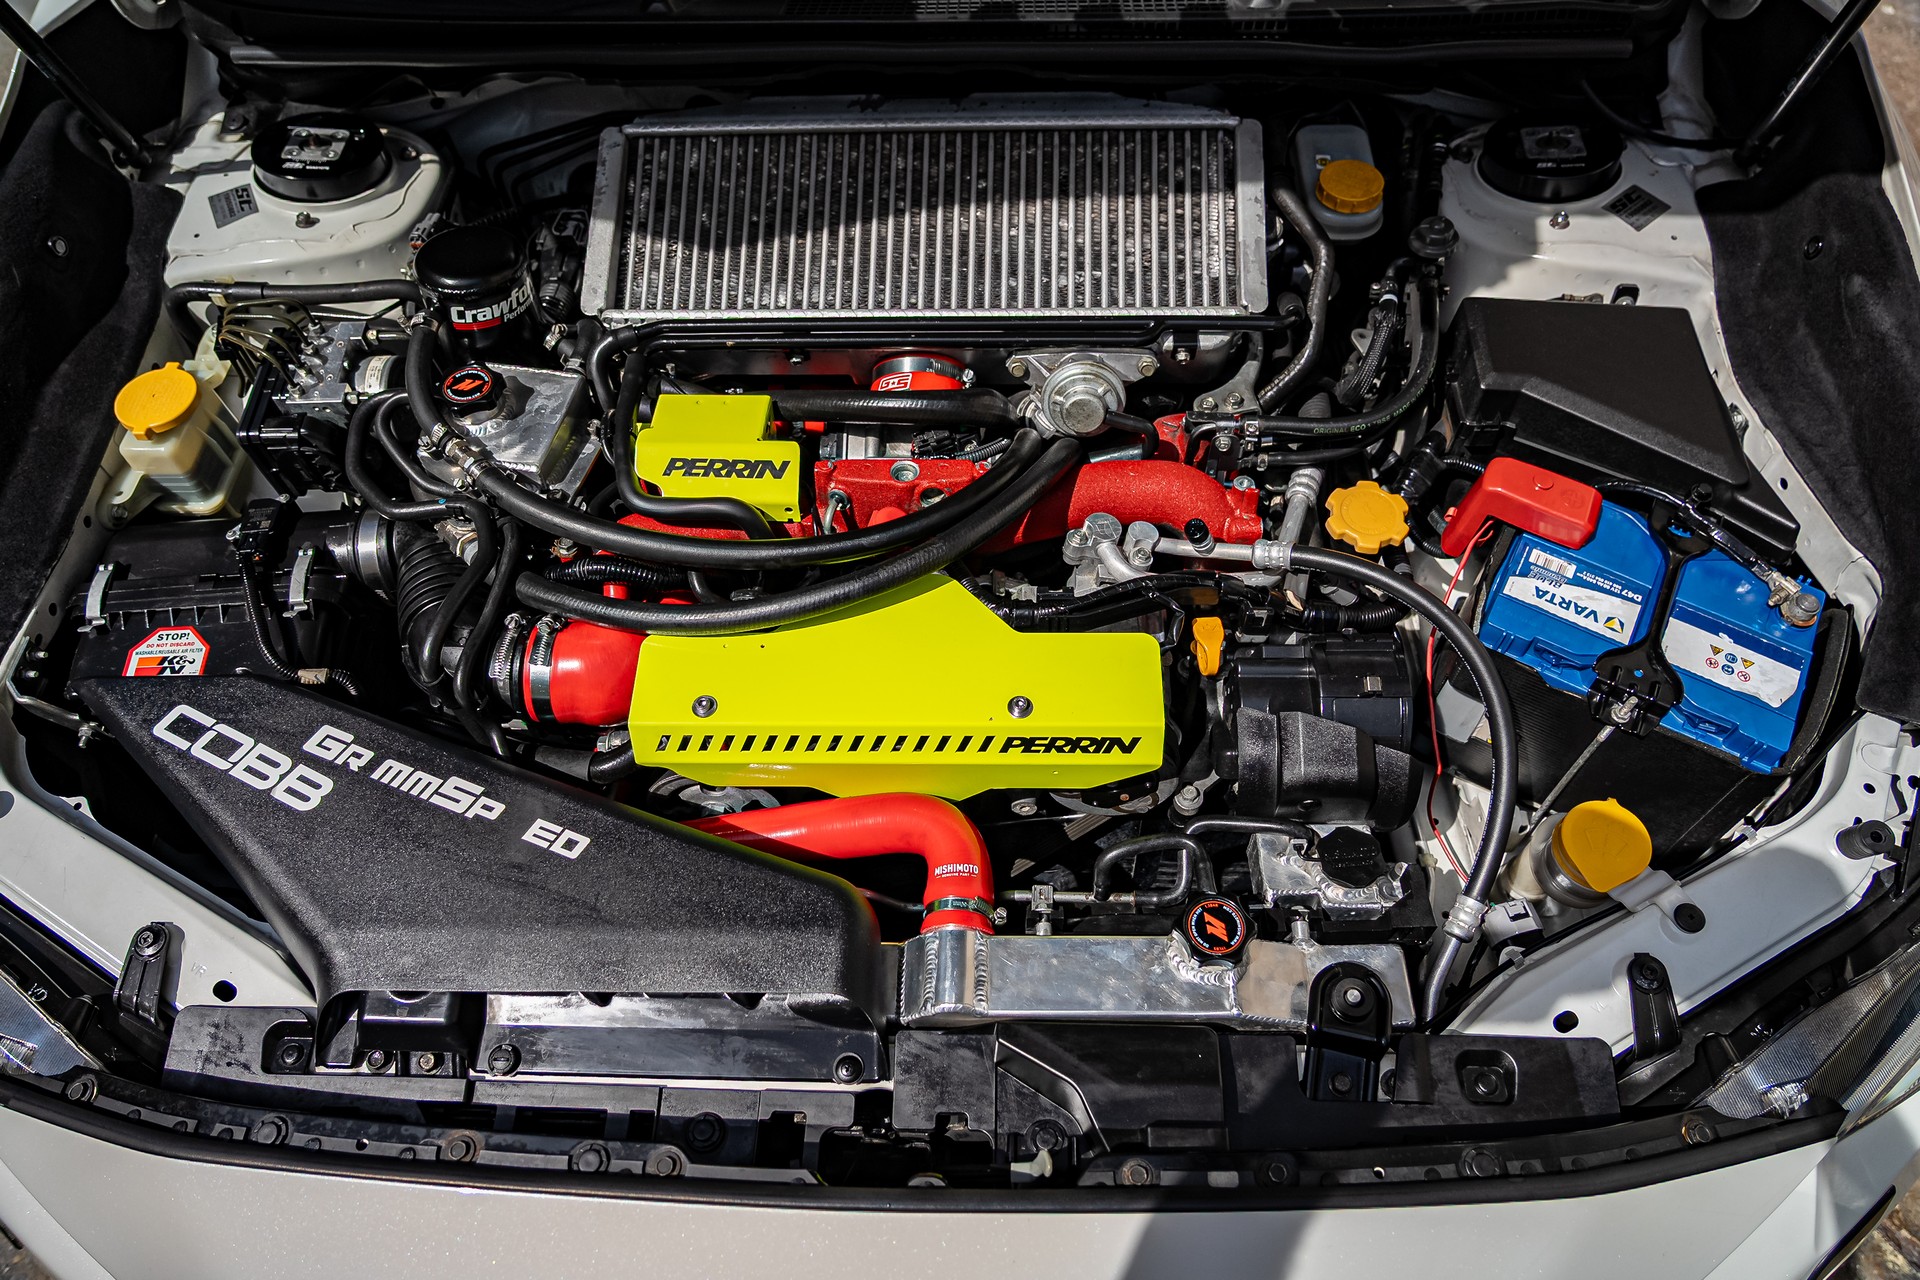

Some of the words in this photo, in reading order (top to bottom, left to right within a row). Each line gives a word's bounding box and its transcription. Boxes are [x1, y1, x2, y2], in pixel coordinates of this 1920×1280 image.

[1350, 424, 1367, 432] ECO
[662, 457, 791, 480] PERRIN
[1527, 570, 1565, 589] BLUE
[1534, 585, 1600, 624] VARTA
[1622, 589, 1643, 602] D47
[157, 632, 191, 641] STOP!
[999, 736, 1142, 755] PERRIN
[153, 704, 334, 812] COBB
[934, 863, 979, 876] MISHIMOTO
